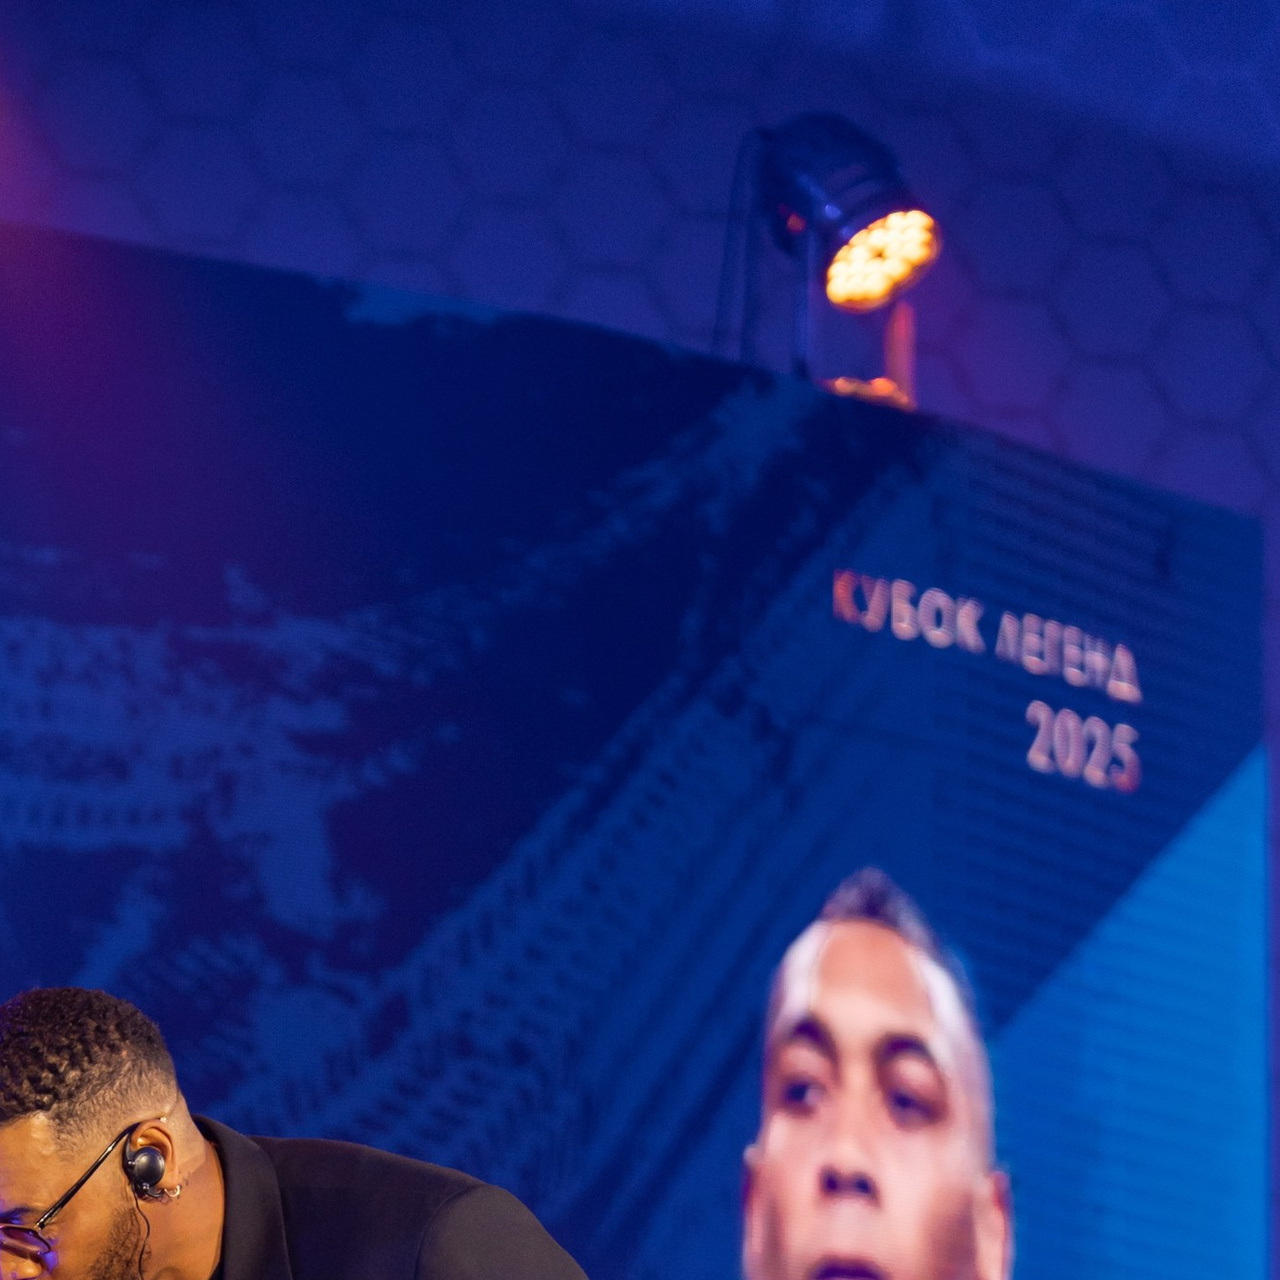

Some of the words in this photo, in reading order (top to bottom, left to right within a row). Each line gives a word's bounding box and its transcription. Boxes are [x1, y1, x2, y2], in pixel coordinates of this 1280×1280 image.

[832, 568, 986, 654] КУБОК
[994, 610, 1143, 704] ЛЕГЕНД
[1025, 700, 1141, 793] 2025
